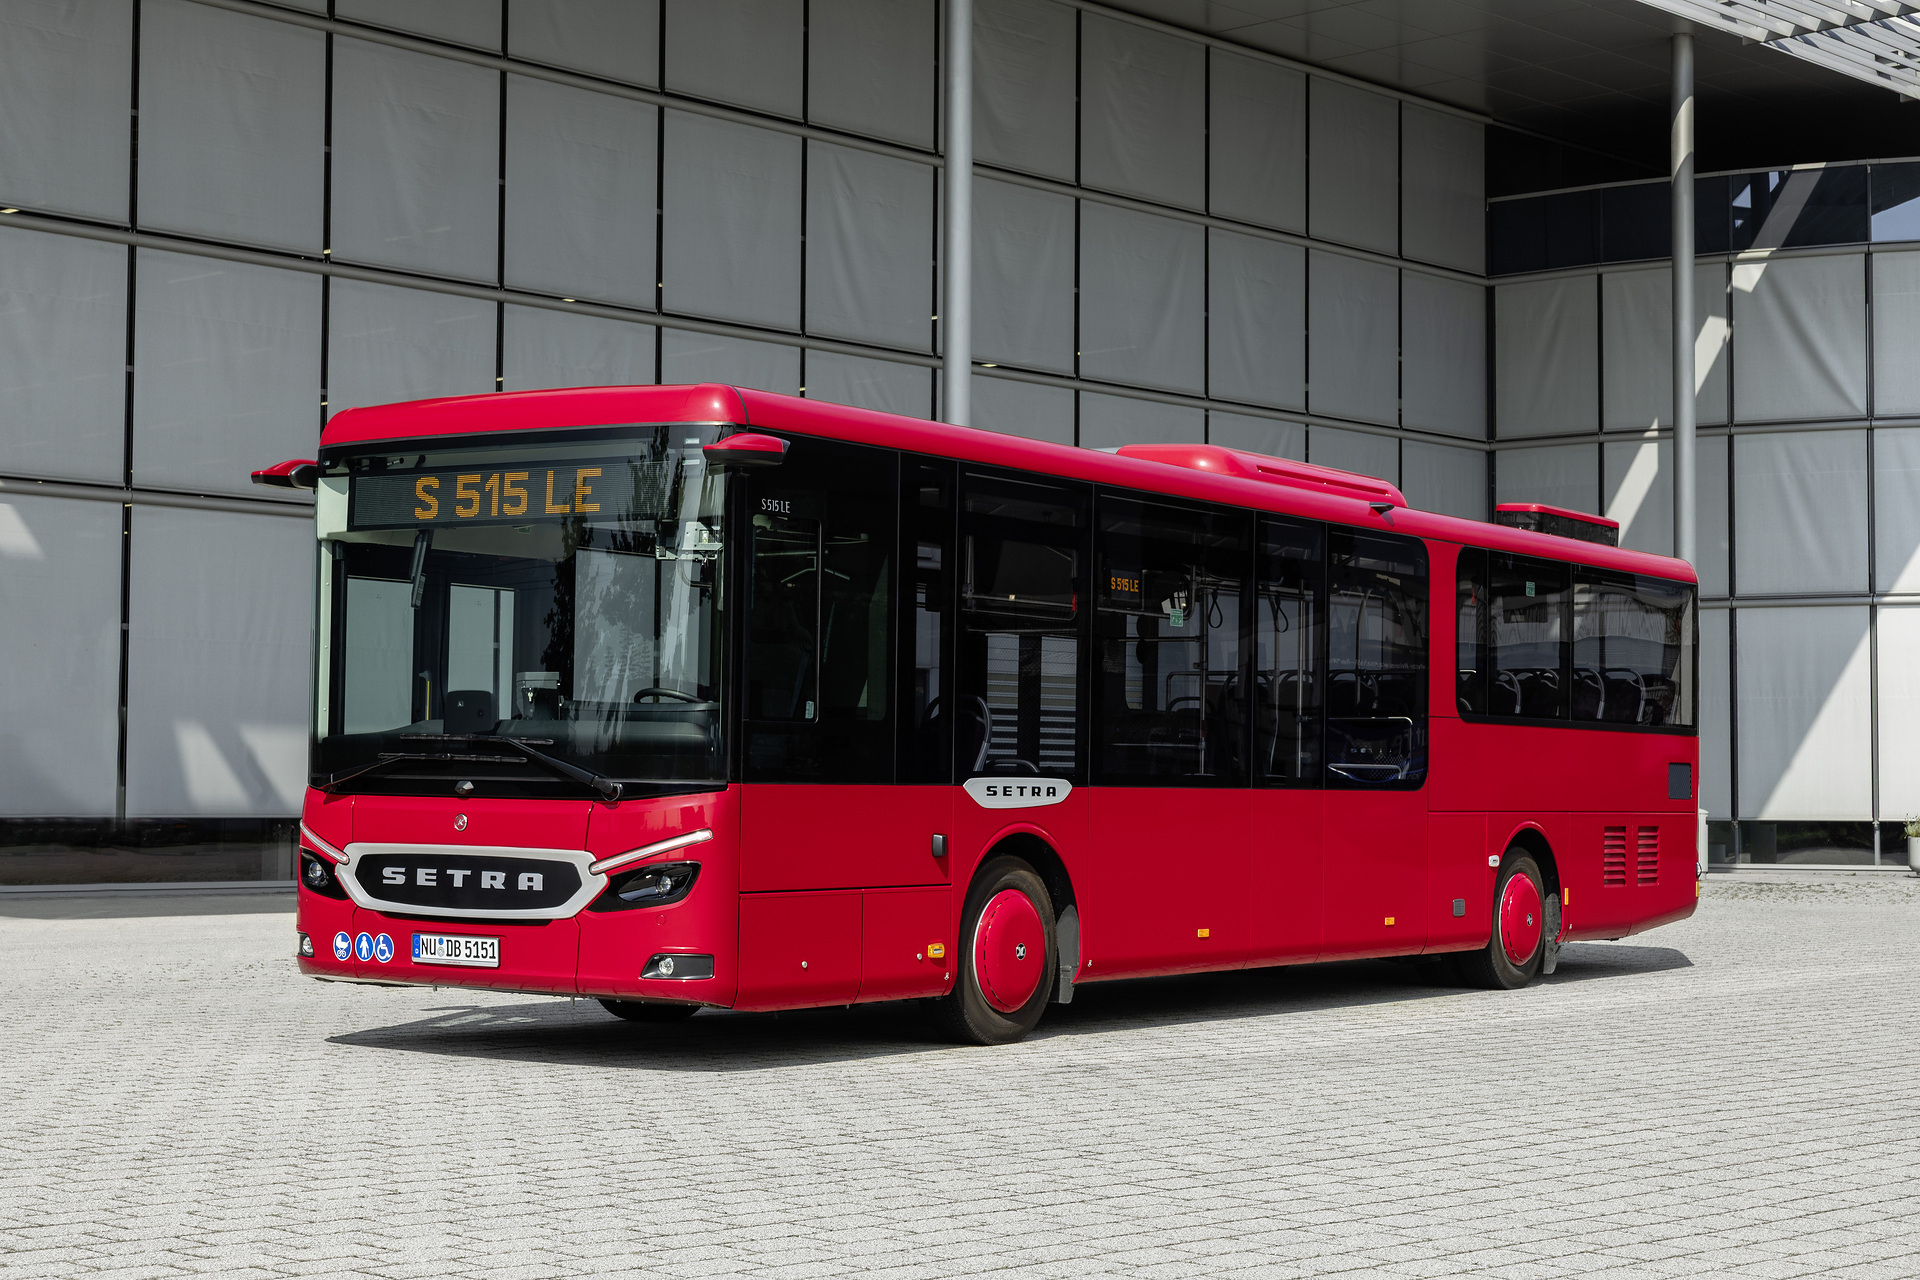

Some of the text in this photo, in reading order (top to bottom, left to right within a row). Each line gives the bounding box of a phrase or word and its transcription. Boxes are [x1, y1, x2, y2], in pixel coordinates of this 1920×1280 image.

[414, 467, 602, 520] S 515 LE
[761, 498, 790, 513] S 515 LE
[1110, 577, 1139, 592] S 515 LE
[986, 785, 1057, 797] SETRA
[382, 866, 544, 891] SETRA
[421, 937, 496, 959] NU DB 5151
